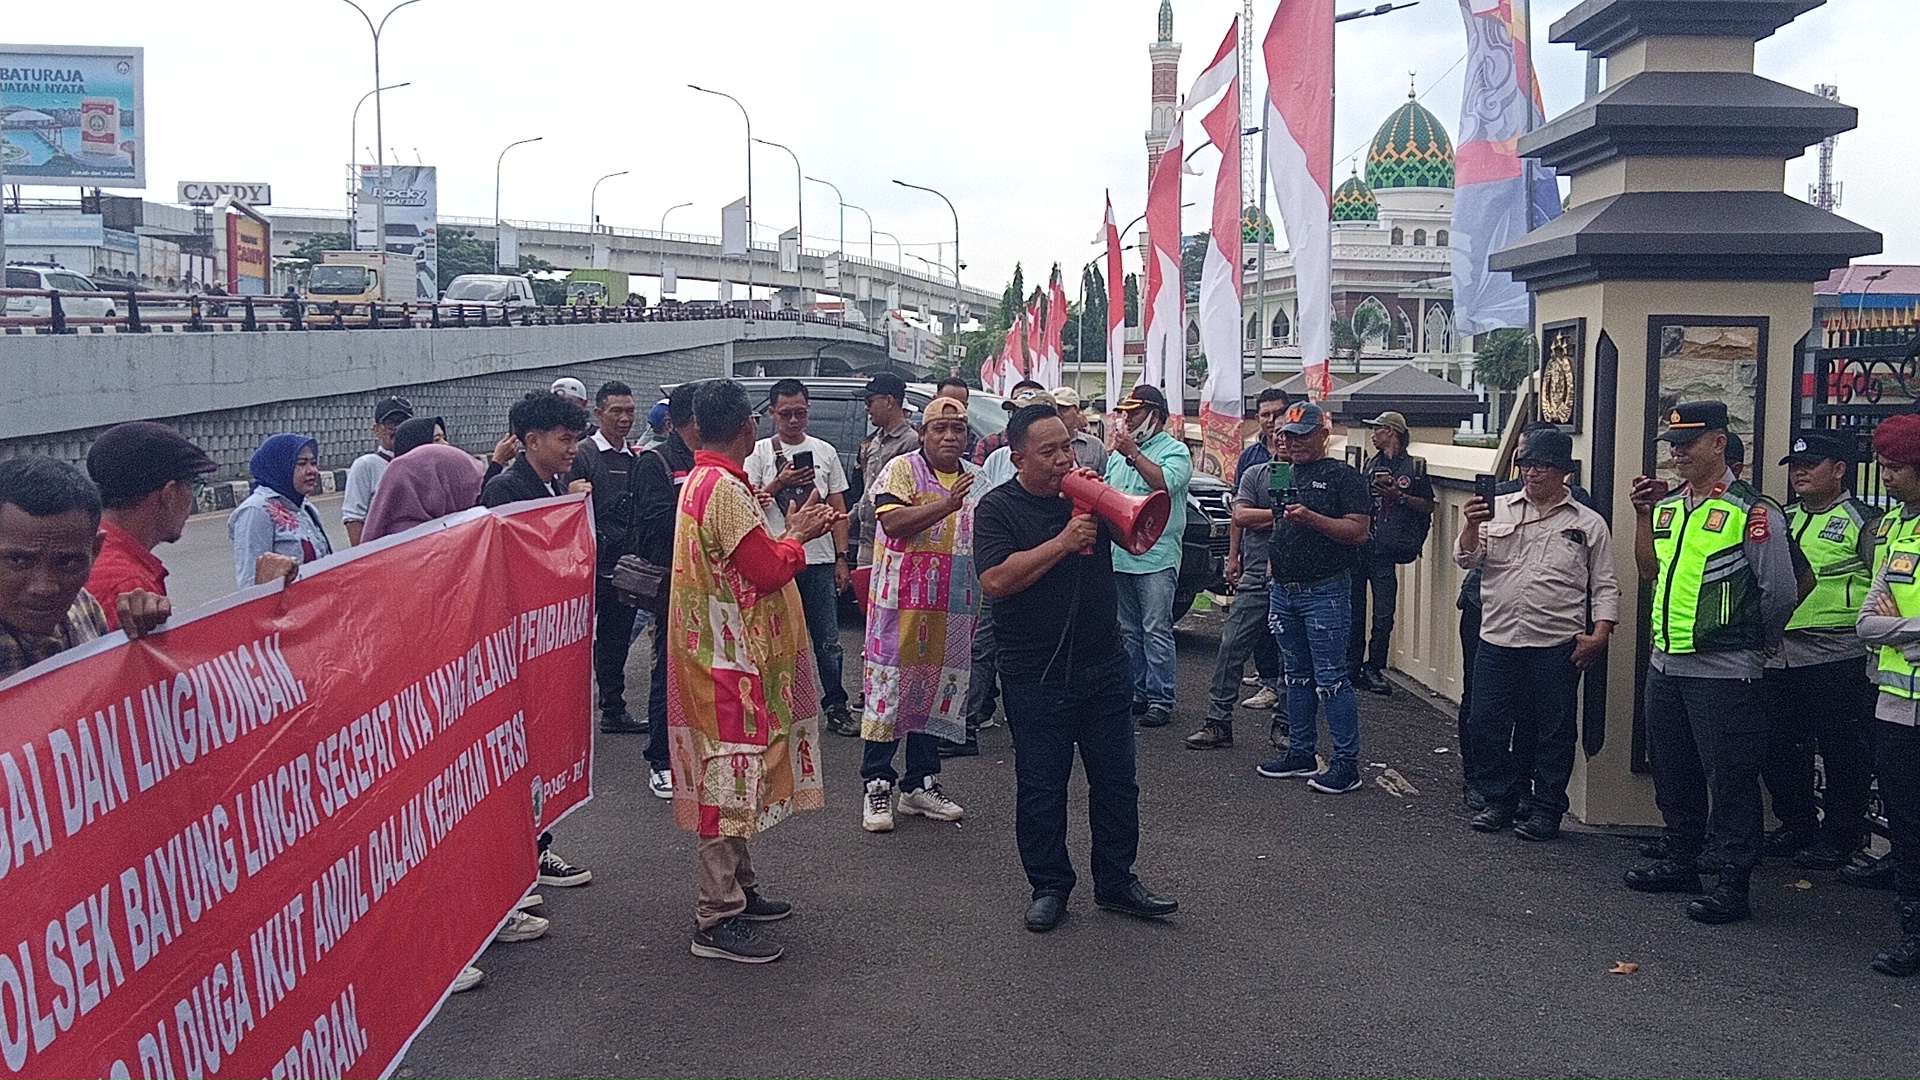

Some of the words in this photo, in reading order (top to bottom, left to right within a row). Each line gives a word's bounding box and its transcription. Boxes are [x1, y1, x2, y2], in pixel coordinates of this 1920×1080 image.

[0, 68, 84, 82] BATURAJA
[45, 84, 85, 94] NYATA
[183, 184, 263, 201] CANDY
[48, 703, 129, 837] DAN
[124, 632, 307, 793] LINGKUNGAN.
[120, 803, 238, 972] BAYUNG
[235, 753, 319, 877] LINCIR
[315, 699, 397, 818] SECEPAT
[393, 681, 434, 760] NYA
[426, 655, 466, 735] YANG
[174, 949, 255, 1080] DUGA
[250, 893, 307, 1019] IKUT
[312, 845, 370, 963] ANDIL
[368, 793, 428, 904] DALAM
[423, 738, 490, 850] KEGIATAN
